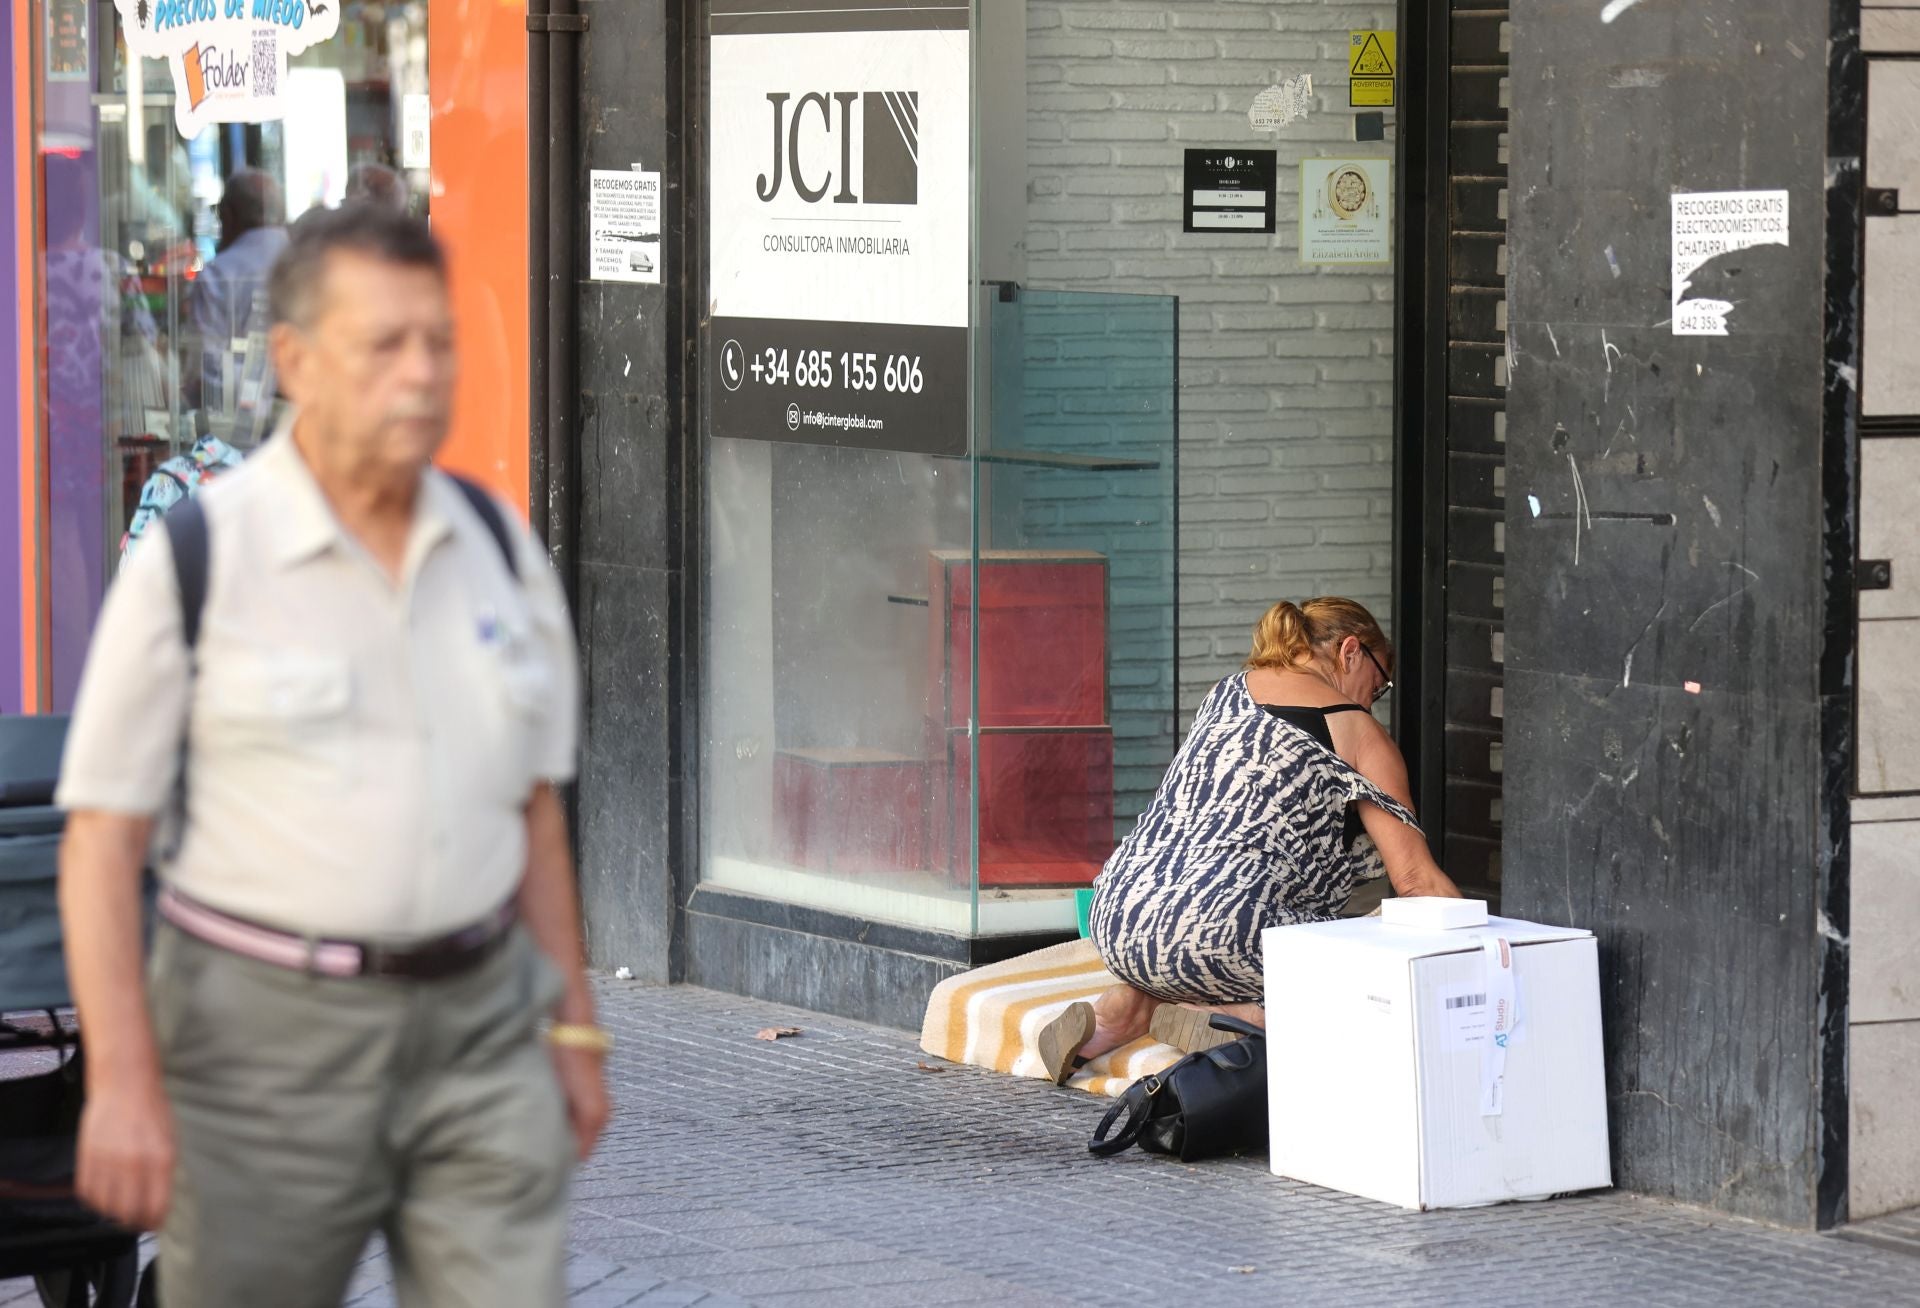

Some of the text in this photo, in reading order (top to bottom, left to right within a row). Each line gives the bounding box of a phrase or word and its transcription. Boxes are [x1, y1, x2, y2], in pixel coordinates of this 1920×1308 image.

[154, 0, 217, 33] PRECIOS
[198, 45, 250, 92] Folder
[756, 91, 859, 204] JCI
[1205, 156, 1255, 169] SUPER
[593, 178, 657, 192] RECOGEMOS GRATIS
[1676, 198, 1784, 216] RECOGEMOS GRATIS
[762, 235, 910, 257] CONSULTORA INMOBILIARIA
[598, 265, 620, 273] PORTES
[1680, 316, 1697, 330] 642
[749, 347, 924, 395] +34 685 155 606
[802, 410, 884, 431] info@jcinterglobal.com
[1495, 998, 1506, 1031] Studio
